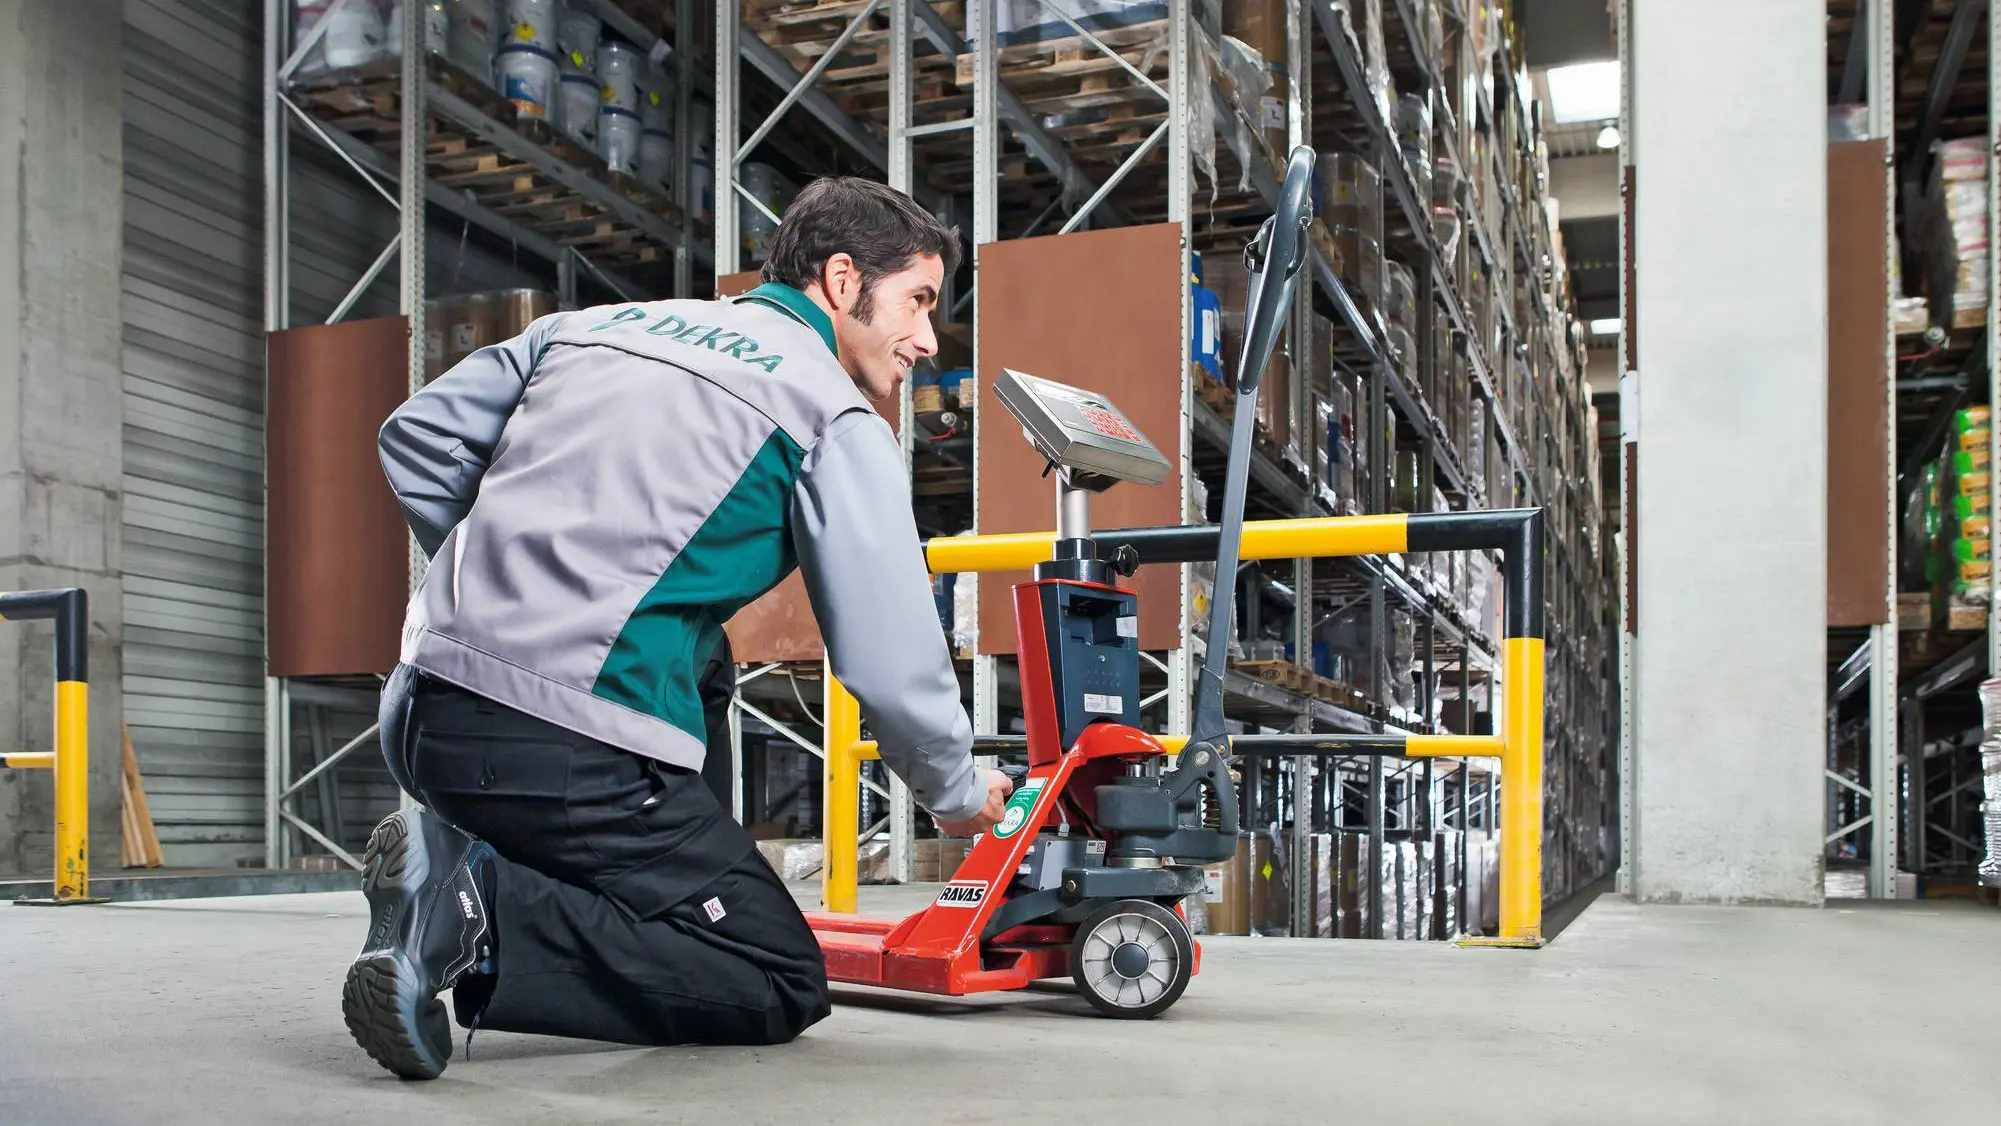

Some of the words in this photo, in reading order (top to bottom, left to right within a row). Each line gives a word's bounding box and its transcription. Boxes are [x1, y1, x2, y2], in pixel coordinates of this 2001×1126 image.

[646, 315, 783, 373] DEKRA
[459, 891, 474, 919] atlas
[939, 887, 985, 901] RAVAS
